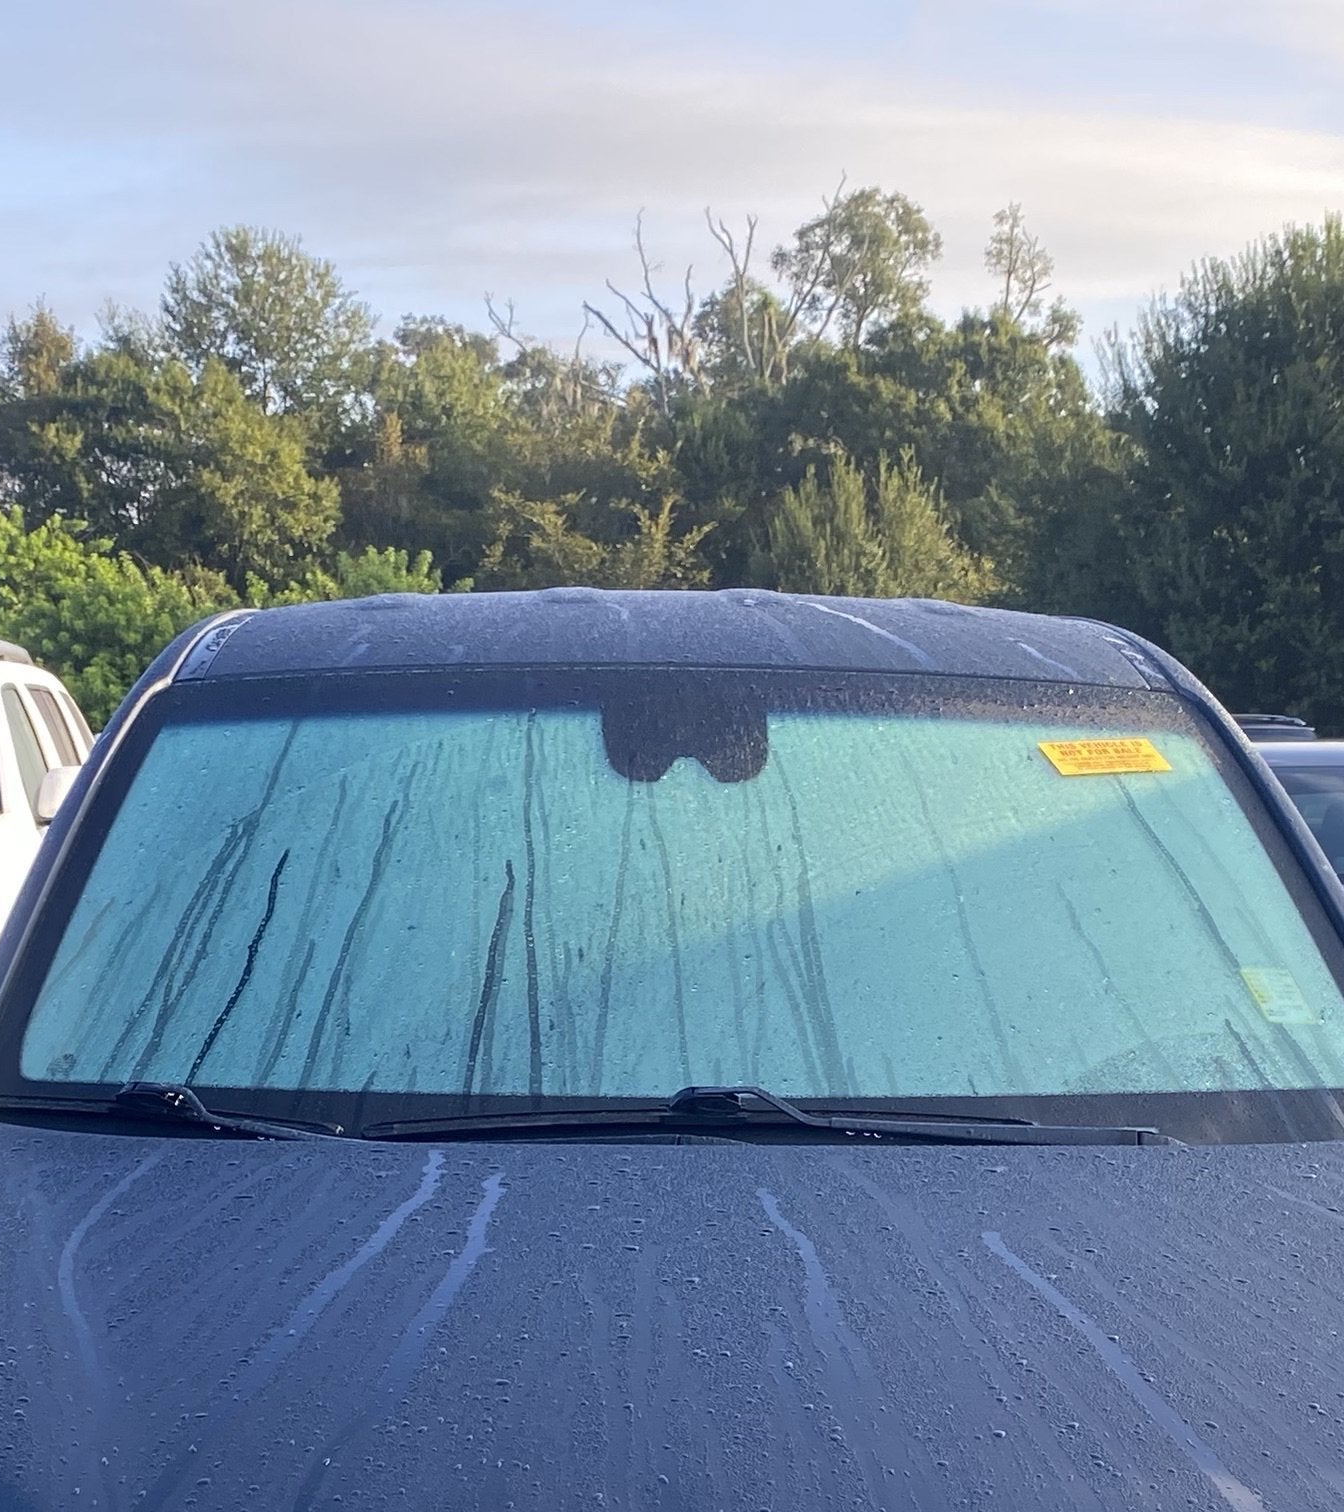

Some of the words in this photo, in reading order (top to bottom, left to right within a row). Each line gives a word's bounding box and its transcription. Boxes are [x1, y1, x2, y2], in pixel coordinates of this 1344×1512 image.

[1078, 741, 1129, 749] VEHICLE
[1085, 748, 1111, 756] FOR
[1112, 747, 1142, 755] SALE
